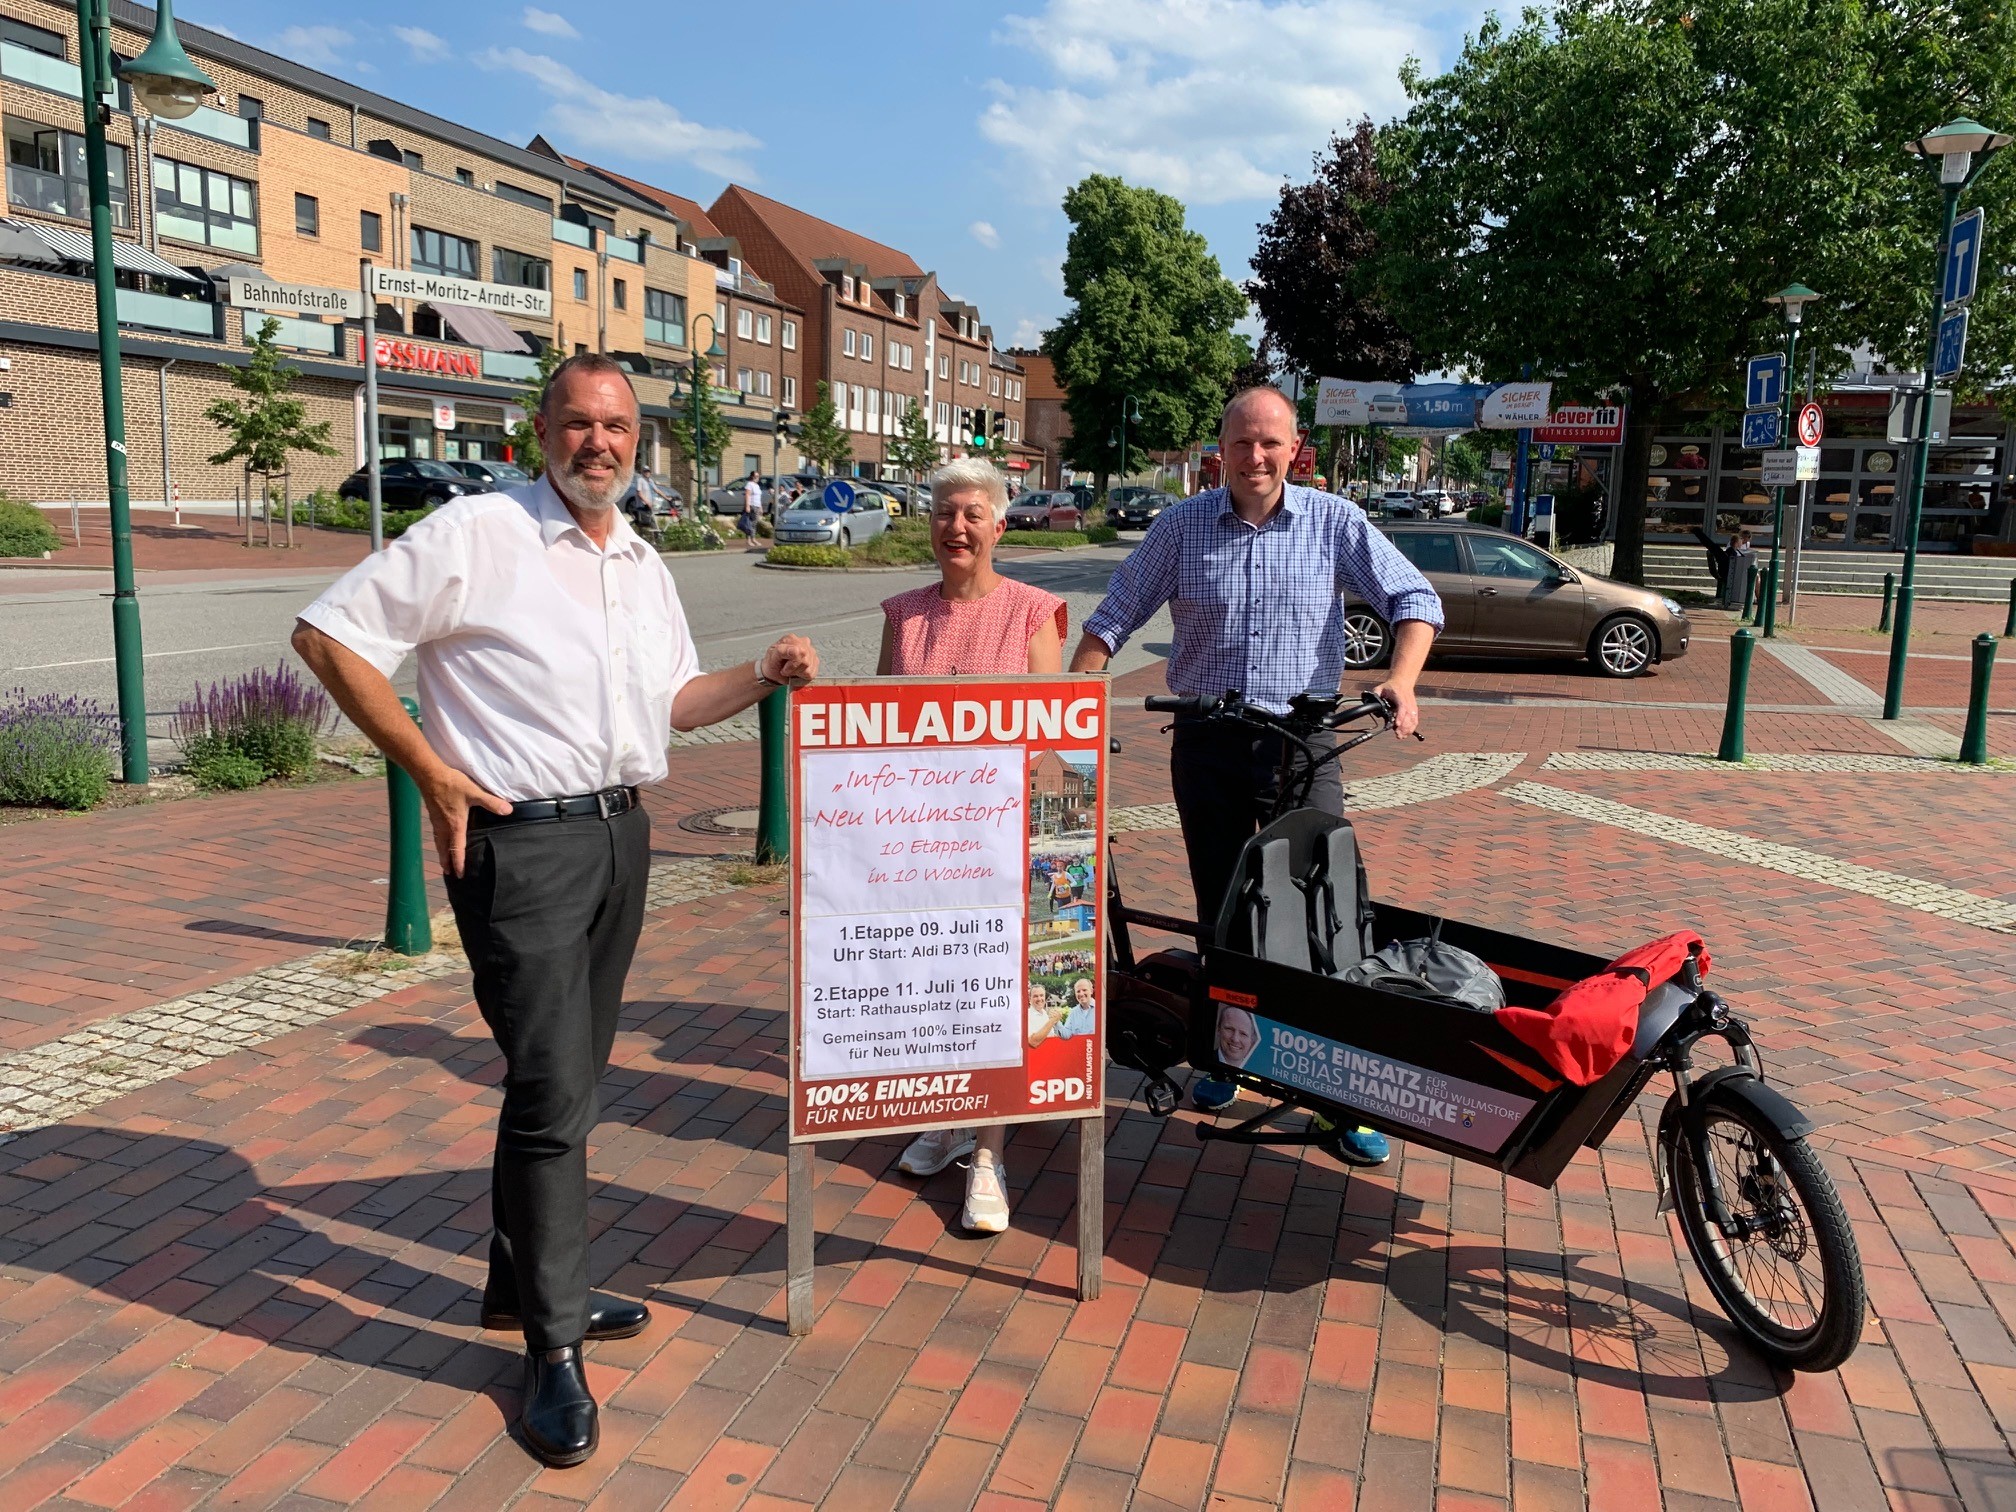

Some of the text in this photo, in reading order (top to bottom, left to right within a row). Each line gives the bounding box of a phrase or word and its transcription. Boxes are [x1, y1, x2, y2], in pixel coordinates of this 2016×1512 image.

[243, 283, 347, 310] Bahnhofstraße
[379, 273, 547, 312] Ernst-Moritz-Arndt-Str.
[1325, 388, 1357, 398] SICHER
[1501, 391, 1541, 403] SICHER
[1336, 408, 1351, 417] adfc
[1423, 401, 1450, 413] 1,50
[1595, 408, 1615, 424] fit
[1540, 428, 1616, 437] FITNESSSTUDIO
[800, 698, 1099, 746] EINLADUNG
[970, 762, 998, 785] de
[814, 808, 863, 827] Neu
[880, 839, 983, 859] 10 Etappen
[867, 864, 995, 884] in 10 Wochen
[840, 919, 1004, 941] 1.Etappe 09. Juli 18
[833, 941, 1009, 962] Uhr Start: Aldi B73 (Rad)
[814, 977, 1014, 1002] 2.Etappe 11. Juli 16 Uhr
[817, 995, 1010, 1020] Start: Rathausplatz (zu Fuß)
[823, 1022, 1002, 1045] Gemeinsam 100% Einsatz
[849, 1039, 977, 1060] für Neu Wulmstorf
[1272, 1027, 1422, 1092] 100% EINSATZ
[805, 1073, 972, 1108] 100% EINSATZ
[1029, 1077, 1085, 1105] SPD
[1270, 1045, 1458, 1123] TOBIAS HANDTKE
[1426, 1076, 1448, 1090] FÜR
[1272, 1066, 1433, 1128] IHR BÜRGERMEISTERKANDIDAT
[1425, 1085, 1522, 1121] NEU WULMSTORF
[806, 1094, 989, 1126] FÜR NEU WULMSTORF!
[1462, 1108, 1476, 1117] SPD
